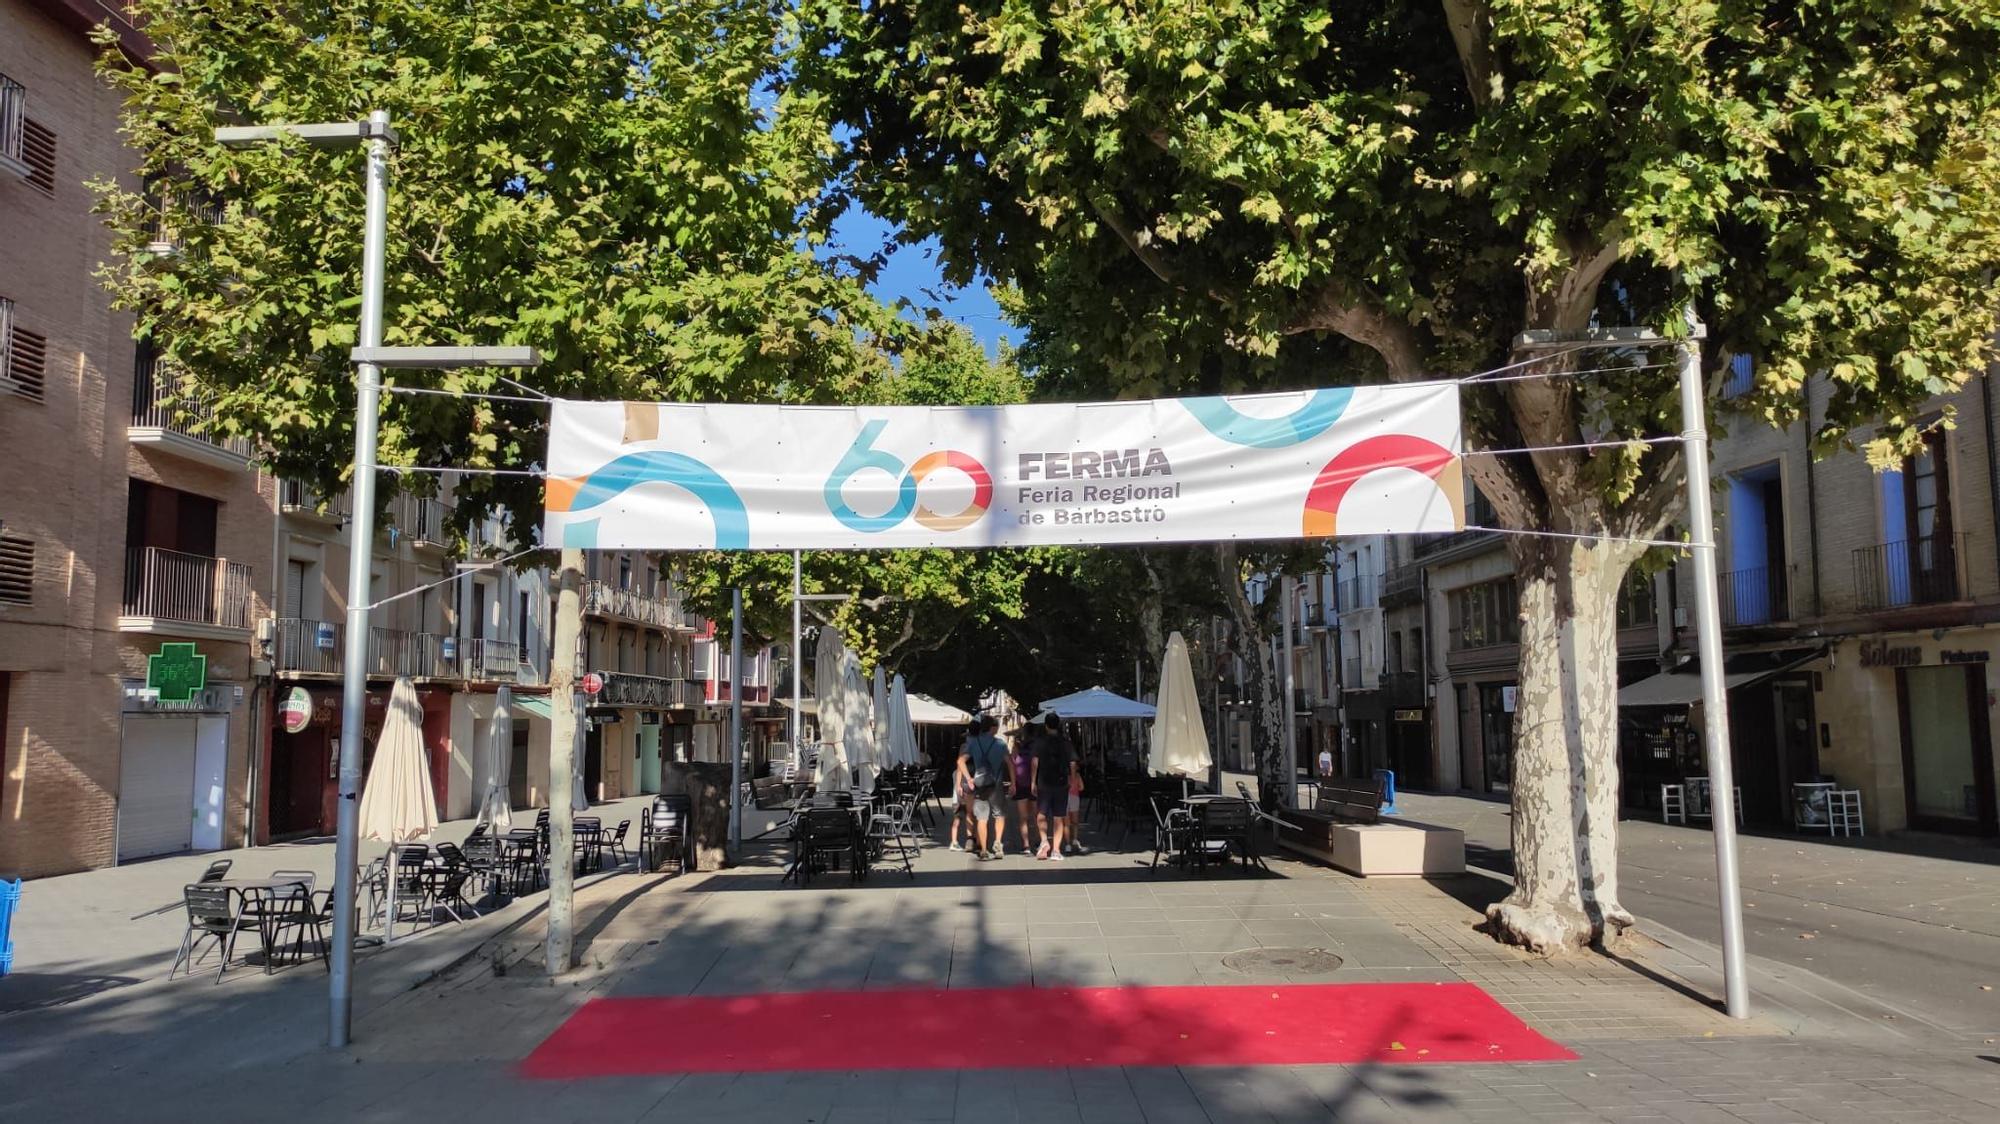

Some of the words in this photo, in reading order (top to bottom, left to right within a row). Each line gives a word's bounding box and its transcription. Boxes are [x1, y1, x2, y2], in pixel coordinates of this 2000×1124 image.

[823, 419, 993, 533] 60
[1018, 448, 1172, 481] FERMA
[1018, 489, 1073, 504] Feria
[1083, 482, 1181, 504] Regional
[1018, 509, 1044, 526] de
[1054, 506, 1166, 526] Barbastro
